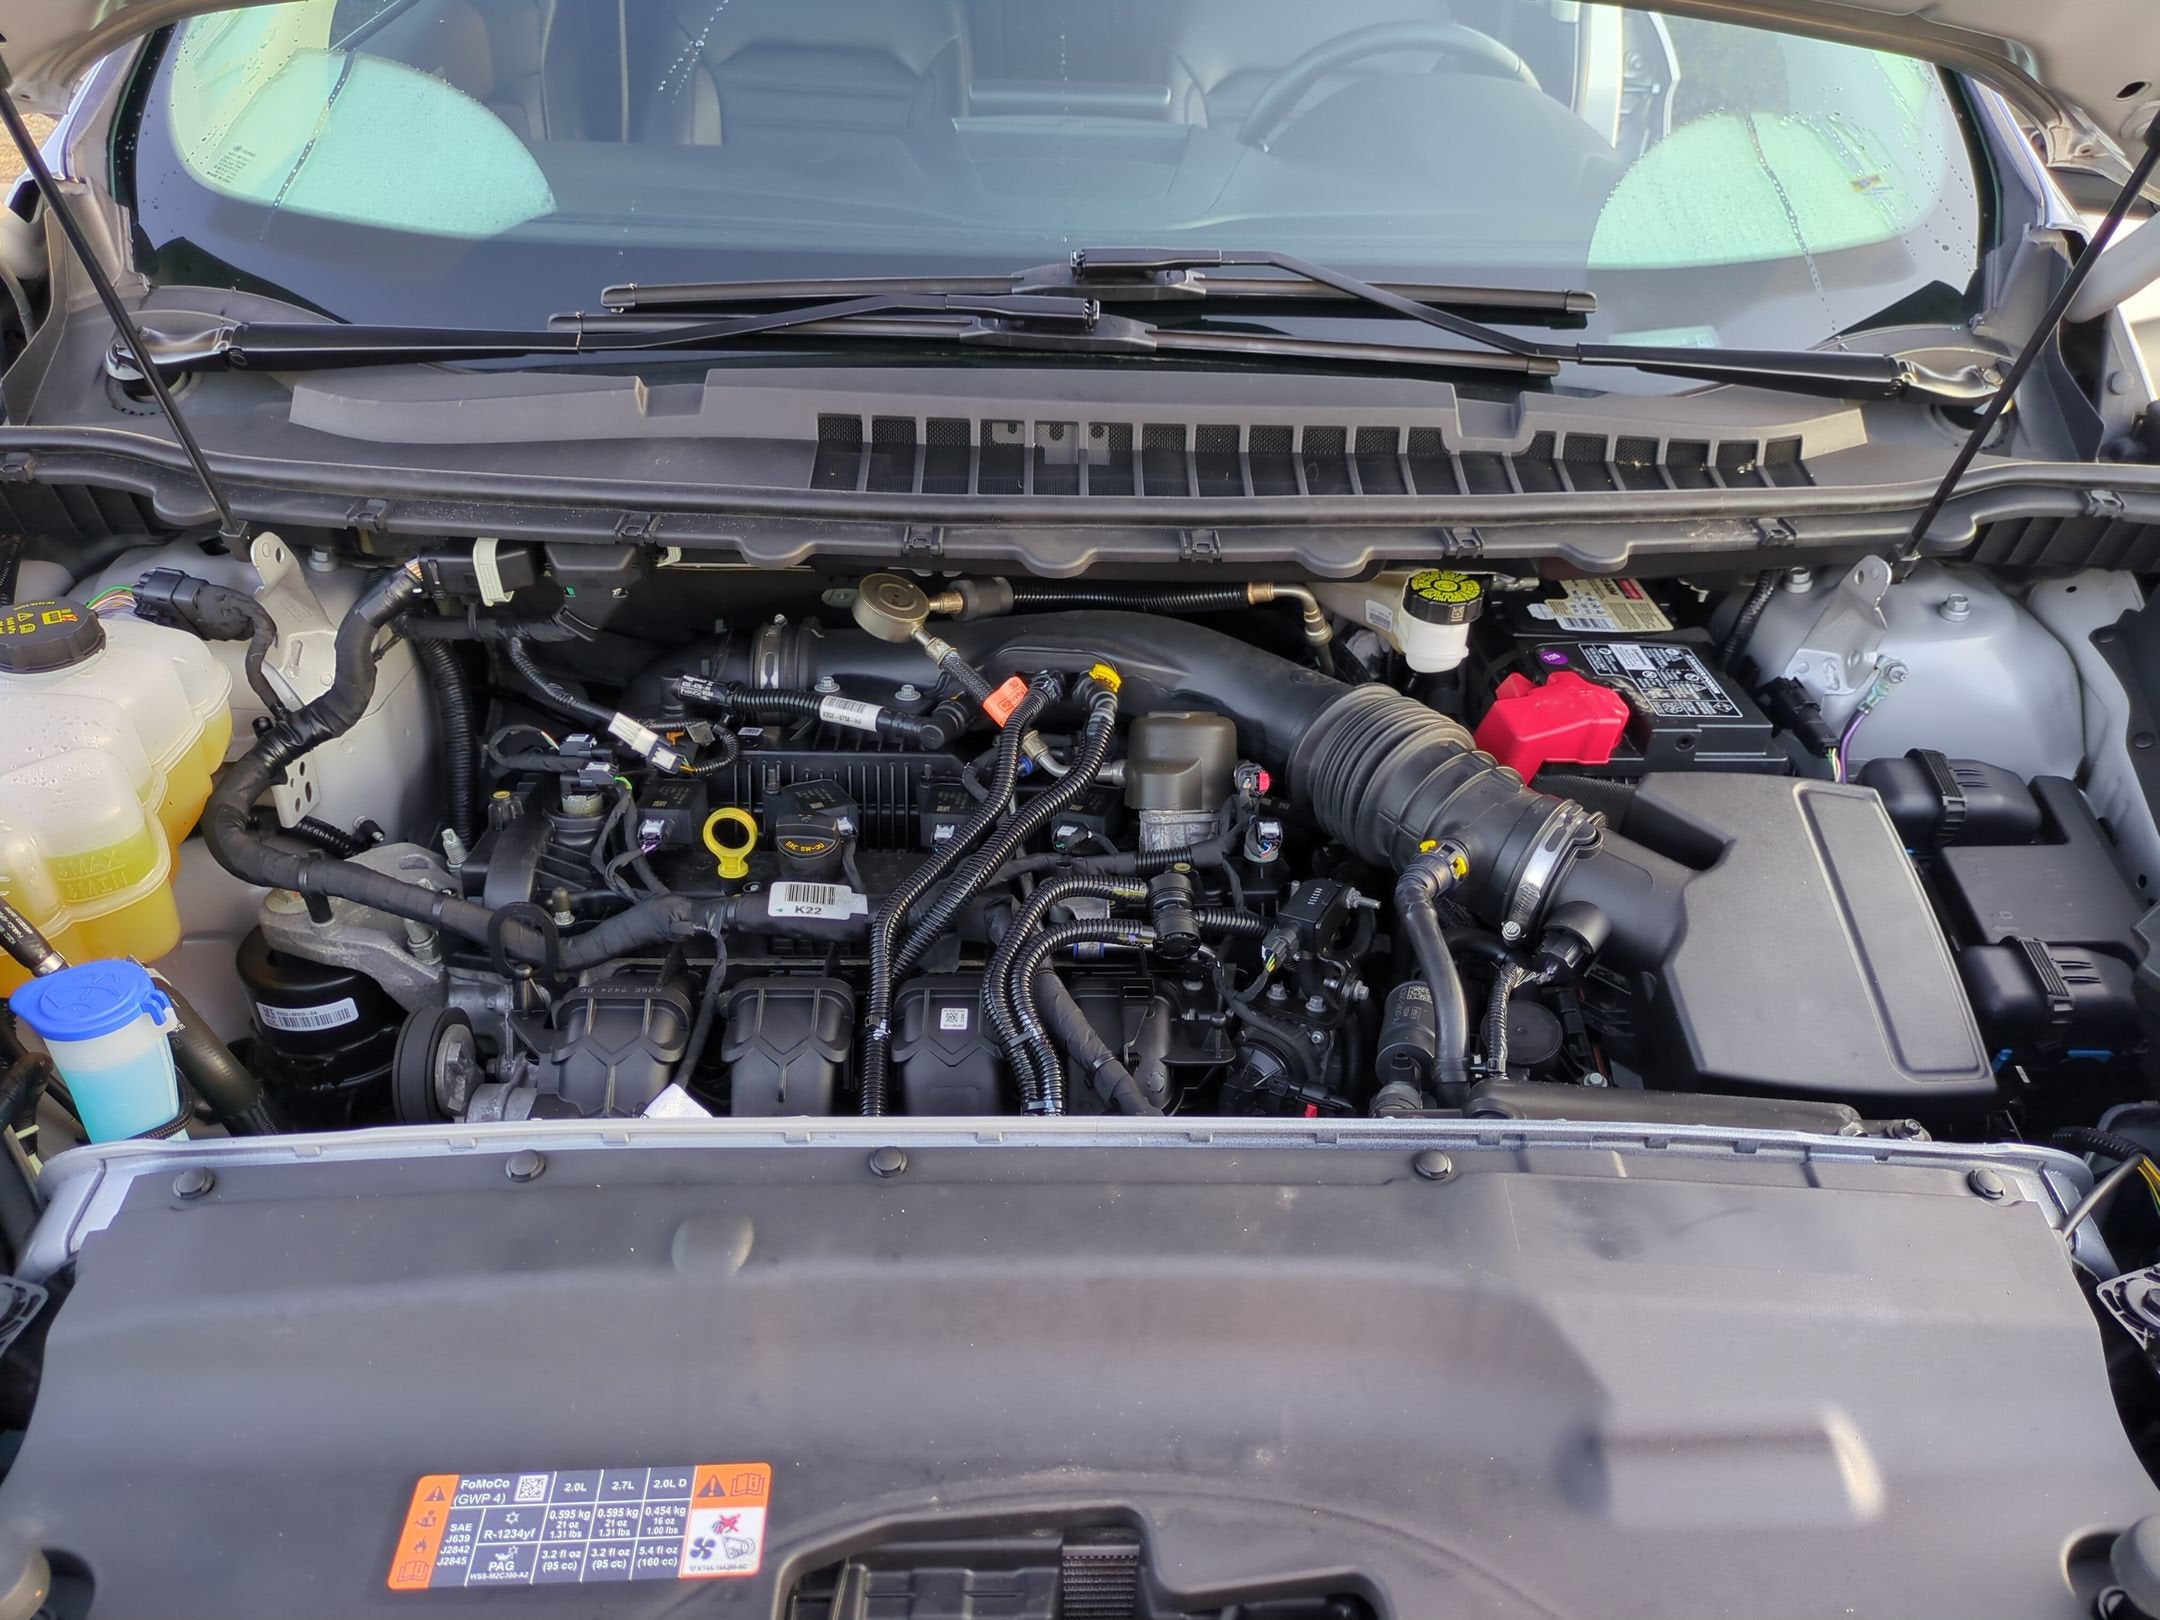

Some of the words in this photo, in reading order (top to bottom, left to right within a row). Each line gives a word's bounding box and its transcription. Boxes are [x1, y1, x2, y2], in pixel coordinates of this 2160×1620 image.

[68, 849, 117, 876] MAX
[80, 871, 129, 898] MIN
[795, 906, 822, 915] K22
[460, 1478, 511, 1491] FoMoCo
[564, 1483, 588, 1493] 2.0L
[611, 1481, 635, 1491] 2.7L
[653, 1479, 676, 1489] 2.0L
[678, 1478, 688, 1489] D
[453, 1493, 491, 1507] (GWP
[492, 1492, 507, 1505] 4)
[549, 1509, 576, 1521] 0.595
[577, 1508, 592, 1521] kg
[597, 1508, 624, 1519] 0.595
[625, 1506, 640, 1519] kg
[645, 1506, 672, 1517] 0.454
[673, 1505, 687, 1517] kg
[556, 1520, 567, 1530] 21
[568, 1521, 580, 1529] oz
[604, 1518, 615, 1528] 21
[616, 1519, 628, 1527] oz
[653, 1516, 663, 1526] 16
[664, 1517, 676, 1526] oz
[449, 1522, 473, 1533] SAE
[598, 1528, 616, 1538] 1.31
[617, 1527, 631, 1537] lbs
[646, 1526, 664, 1536] 1.00
[665, 1525, 679, 1535] lbs
[445, 1534, 471, 1544] J639
[483, 1527, 537, 1541] R-1234yf
[549, 1530, 567, 1540] 1.31
[568, 1529, 582, 1538] lbs
[440, 1545, 471, 1556] J2842
[541, 1550, 558, 1560] 3.2
[559, 1549, 567, 1559] fl
[568, 1550, 582, 1559] oz
[590, 1548, 607, 1558] 3.2
[608, 1547, 616, 1557] fl
[617, 1548, 631, 1556] oz
[638, 1546, 655, 1556] 5.4
[656, 1545, 664, 1555] fl
[665, 1546, 679, 1554] oz
[436, 1556, 468, 1567] J2845
[488, 1561, 515, 1572] PAG
[542, 1561, 559, 1573] (95
[560, 1560, 578, 1571] cc)
[592, 1560, 609, 1572] (95
[610, 1558, 628, 1570] cc)
[637, 1557, 660, 1569] (160
[661, 1556, 679, 1568] cc)
